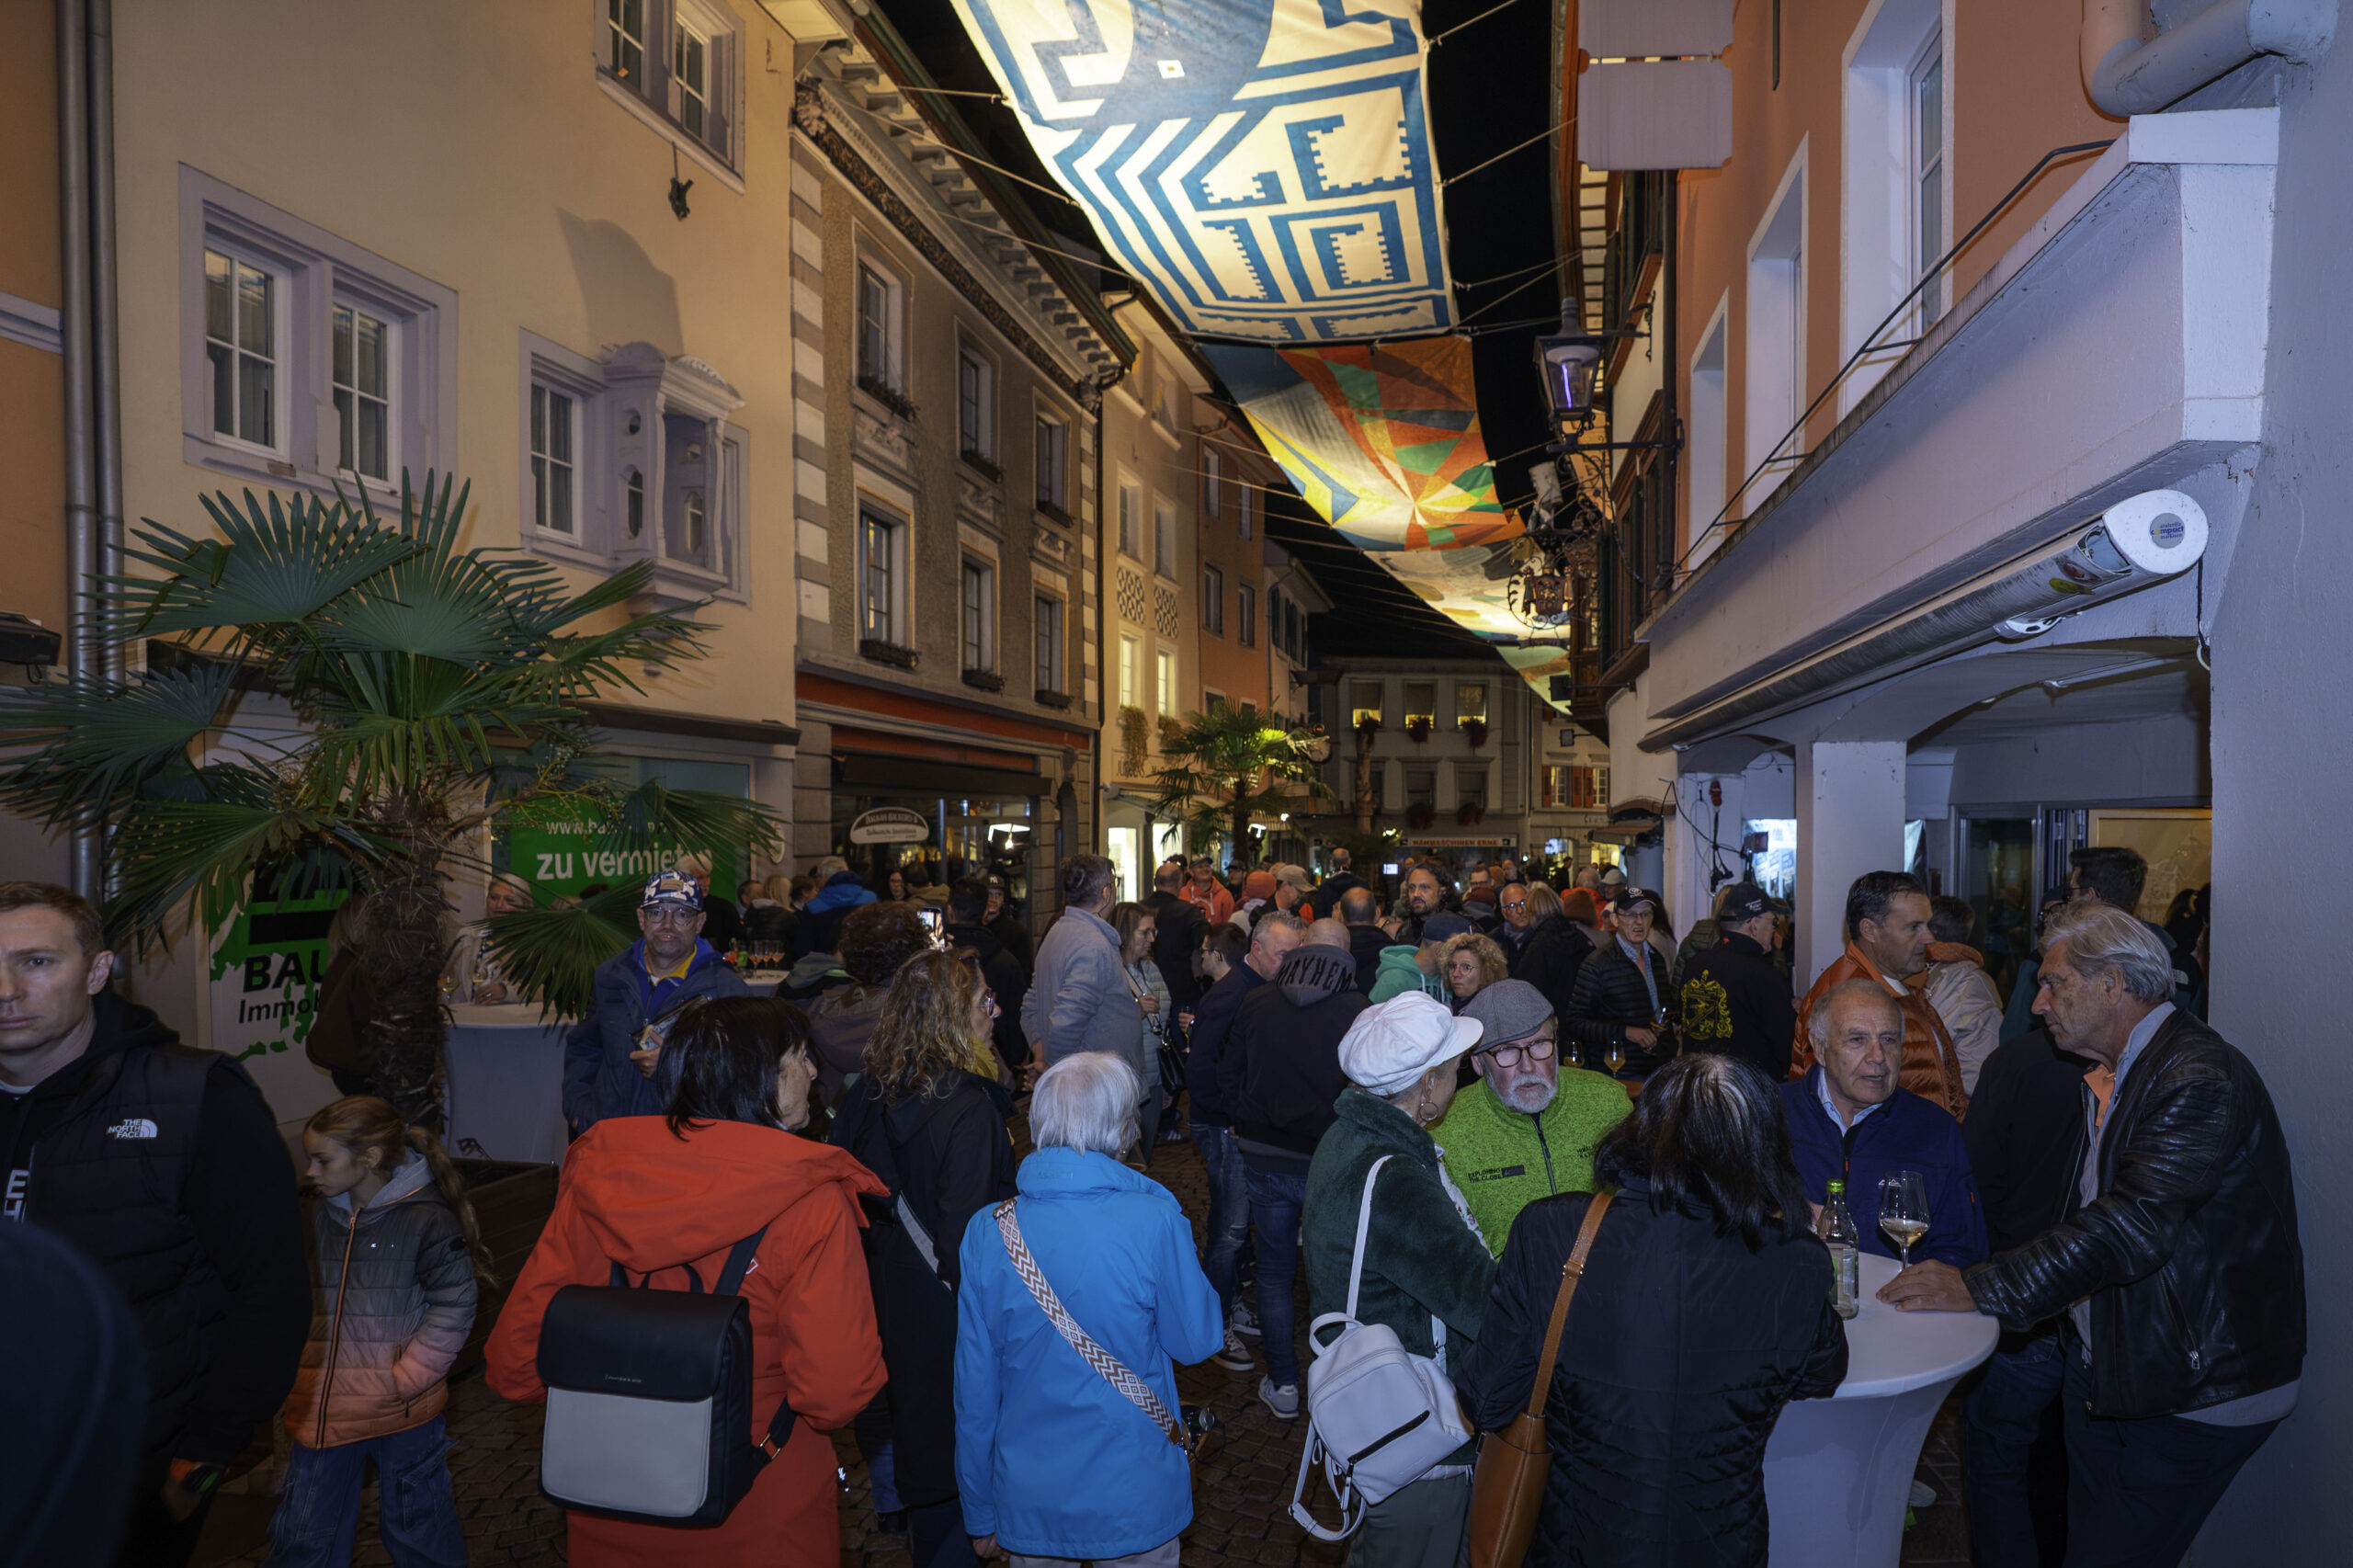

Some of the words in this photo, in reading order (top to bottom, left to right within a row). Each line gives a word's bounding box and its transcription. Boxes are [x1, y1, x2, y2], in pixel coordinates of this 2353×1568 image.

[537, 853, 574, 881] zu
[582, 842, 712, 878] vermiet
[1275, 955, 1353, 994] MAYHEM
[123, 1119, 142, 1127] THE
[107, 1125, 142, 1134] NORTH
[115, 1131, 142, 1140] FACE
